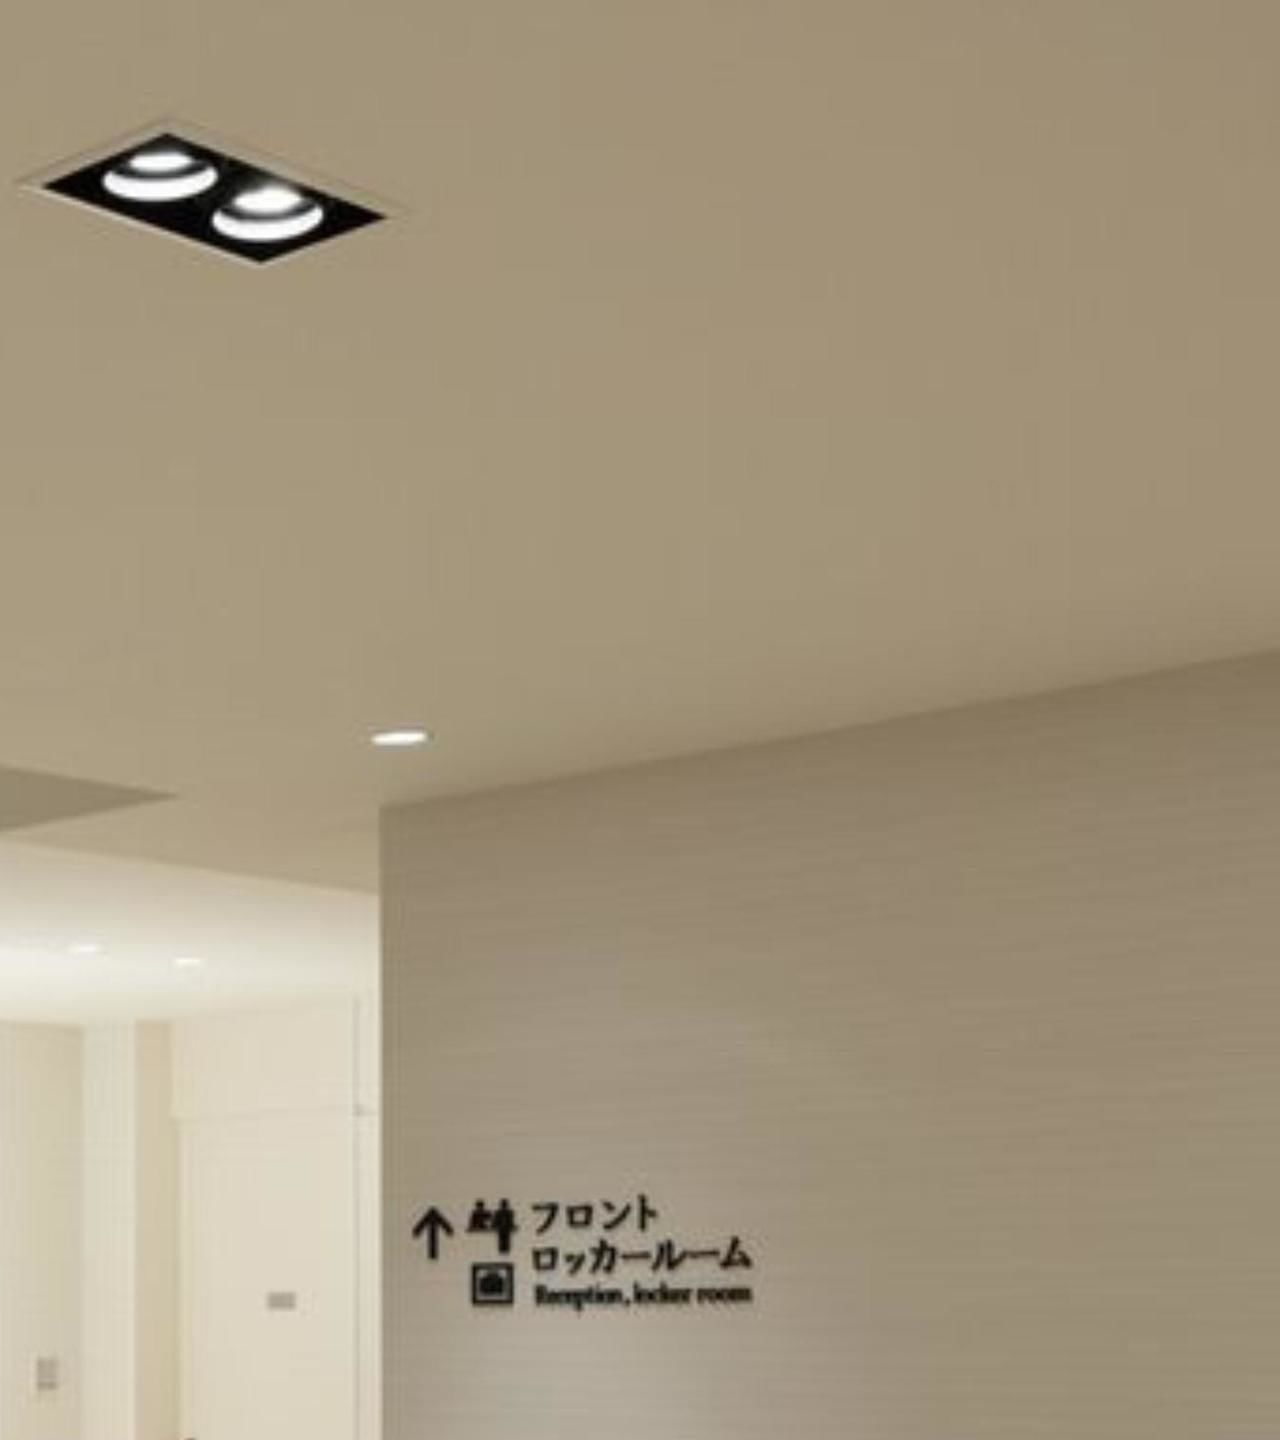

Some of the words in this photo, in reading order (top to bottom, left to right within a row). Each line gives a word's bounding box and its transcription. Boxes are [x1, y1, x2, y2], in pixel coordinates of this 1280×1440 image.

[532, 1194, 657, 1235] フロント
[532, 1237, 753, 1275] ロッカールーム
